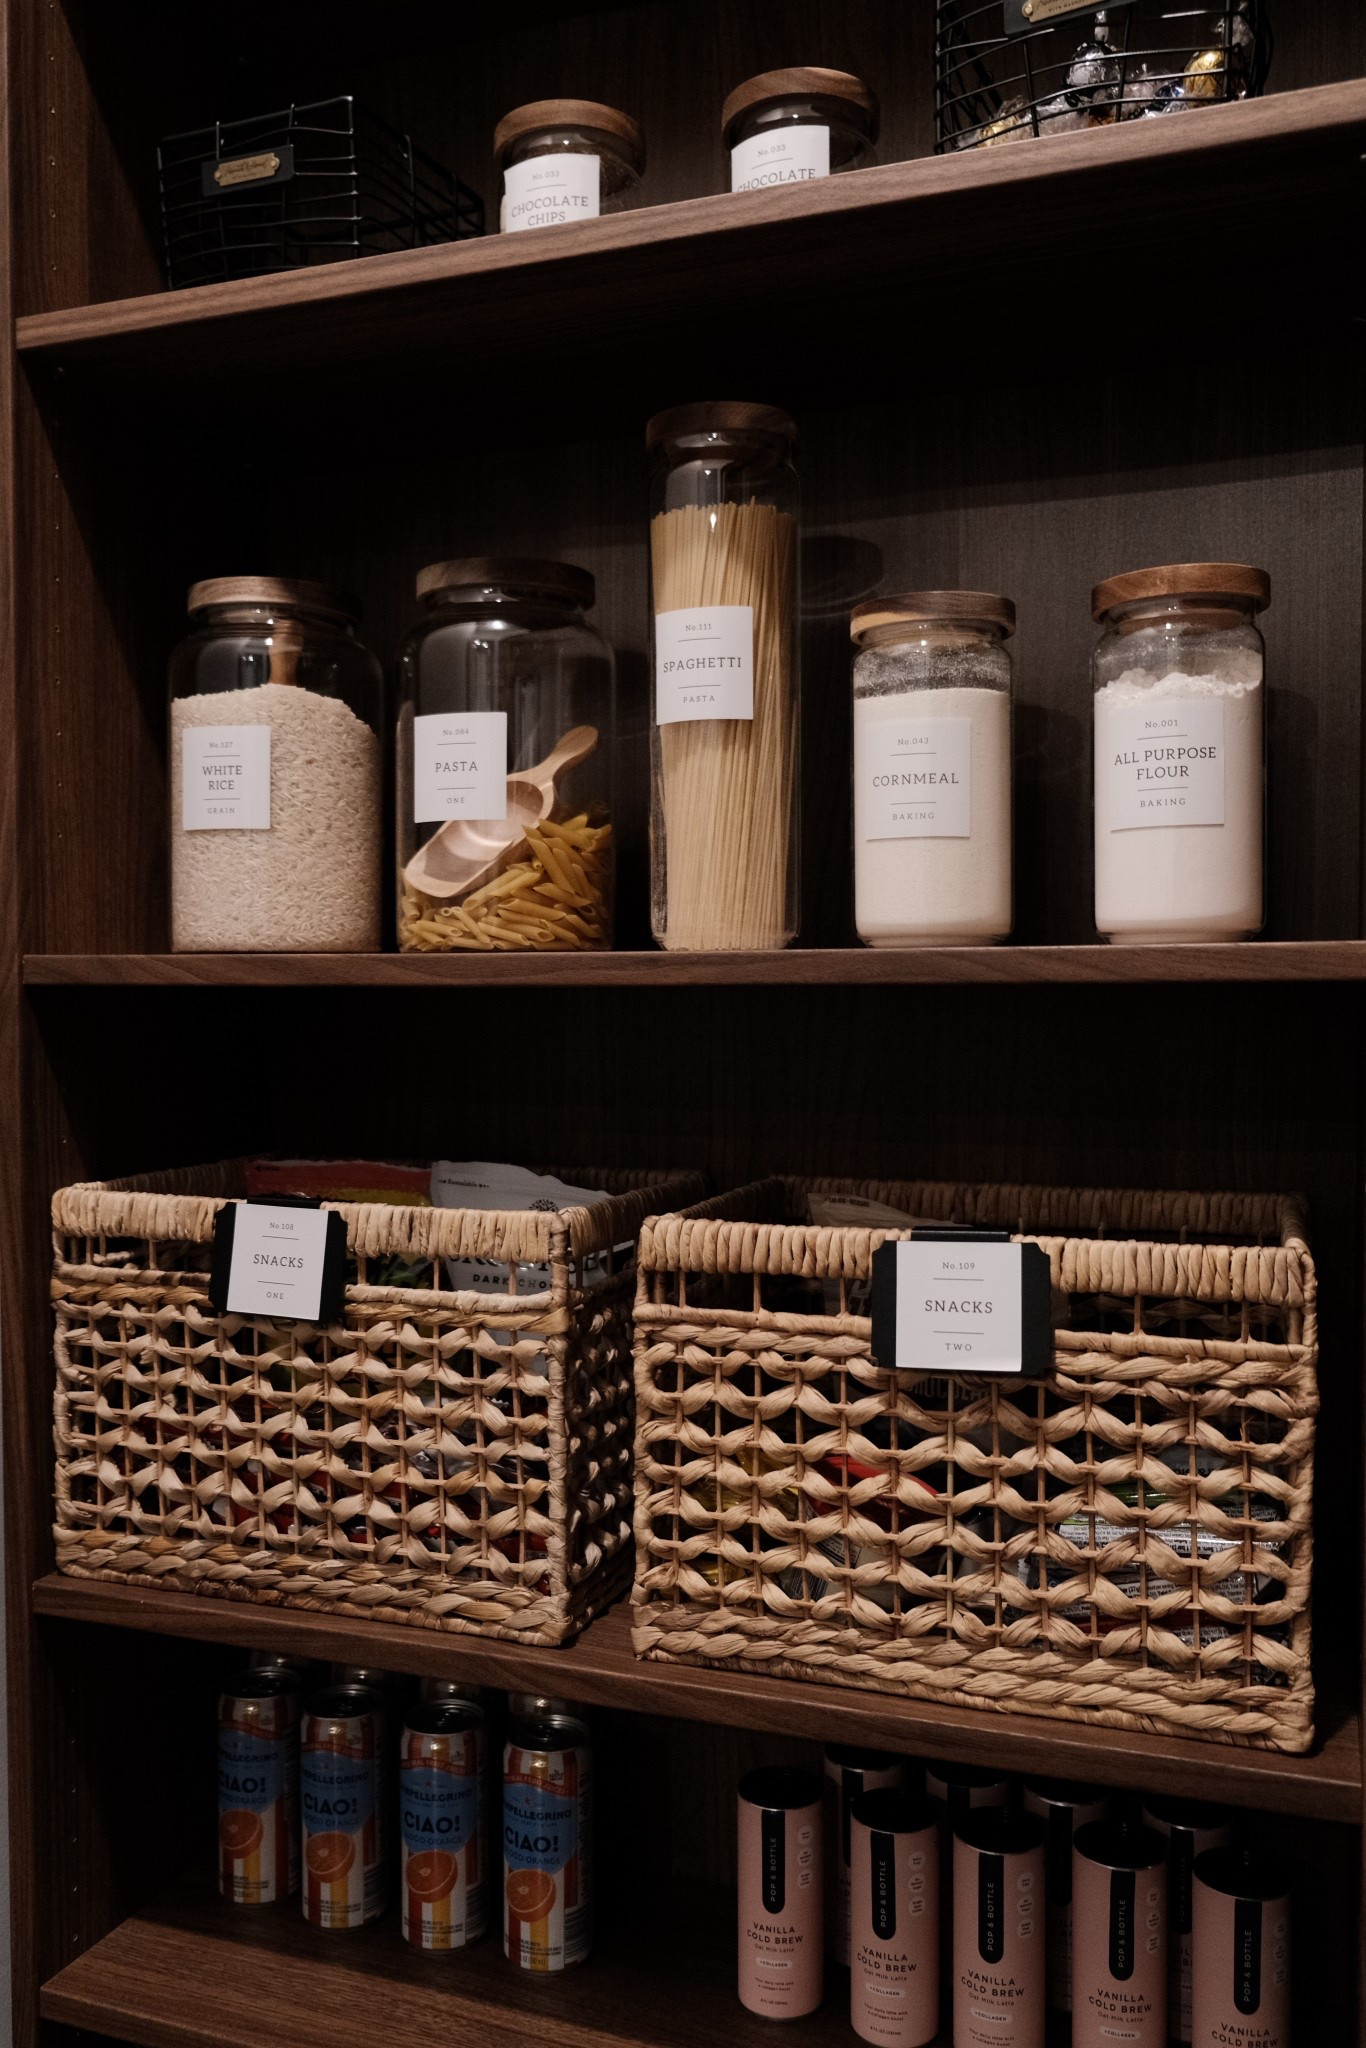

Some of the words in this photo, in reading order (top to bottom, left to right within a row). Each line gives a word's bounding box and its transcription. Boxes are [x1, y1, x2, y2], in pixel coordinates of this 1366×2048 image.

[511, 195, 589, 218] CHOCOLATE
[527, 211, 566, 226] CHIPS
[663, 656, 742, 673] SPAGHETTI
[683, 695, 715, 703] PASTA
[1145, 719, 1179, 729] No.001
[1114, 751, 1140, 766] ALL
[1144, 746, 1217, 762] PURPOSE
[202, 765, 243, 776] WHITE
[435, 761, 478, 773] PASTA
[1136, 765, 1189, 780] FLOUR
[208, 780, 235, 790] RICE
[872, 772, 960, 787] CORNMEAL
[1140, 797, 1186, 808] BAKING
[892, 812, 935, 821] BAKING
[269, 1222, 294, 1230] No.108
[253, 1253, 304, 1269] SNACKS
[942, 1262, 975, 1270] No.109
[266, 1291, 284, 1300] ONE
[924, 1299, 993, 1314] SNACKS
[945, 1342, 972, 1351] TWO
[304, 1793, 357, 1816] CIAO!
[404, 1811, 460, 1834] CIAO!
[504, 1825, 559, 1853] CIAO!
[879, 1859, 887, 1896] BOTTLE
[1118, 1899, 1126, 1935] BOTTLE
[753, 1922, 795, 1934] VANILLA
[746, 1929, 770, 1943] COLD
[774, 1935, 803, 1944] BREW
[862, 1945, 908, 1962] VANILLA
[1243, 1930, 1252, 1968] BOTTLE
[857, 1952, 881, 1969] COLD
[885, 1963, 917, 1973] BREW
[967, 1969, 1016, 1986] VANILLA
[961, 1976, 987, 1994] COLD
[992, 1988, 1025, 1997] BREW
[1243, 1980, 1251, 2002] POP
[1097, 1988, 1145, 2003] VANILLA
[1088, 1995, 1116, 2011] COLD
[1121, 2003, 1152, 2013] BREW
[1220, 2022, 1270, 2037] VANILLA
[1211, 2030, 1242, 2047] COLD
[1247, 2038, 1279, 2048] BREW
